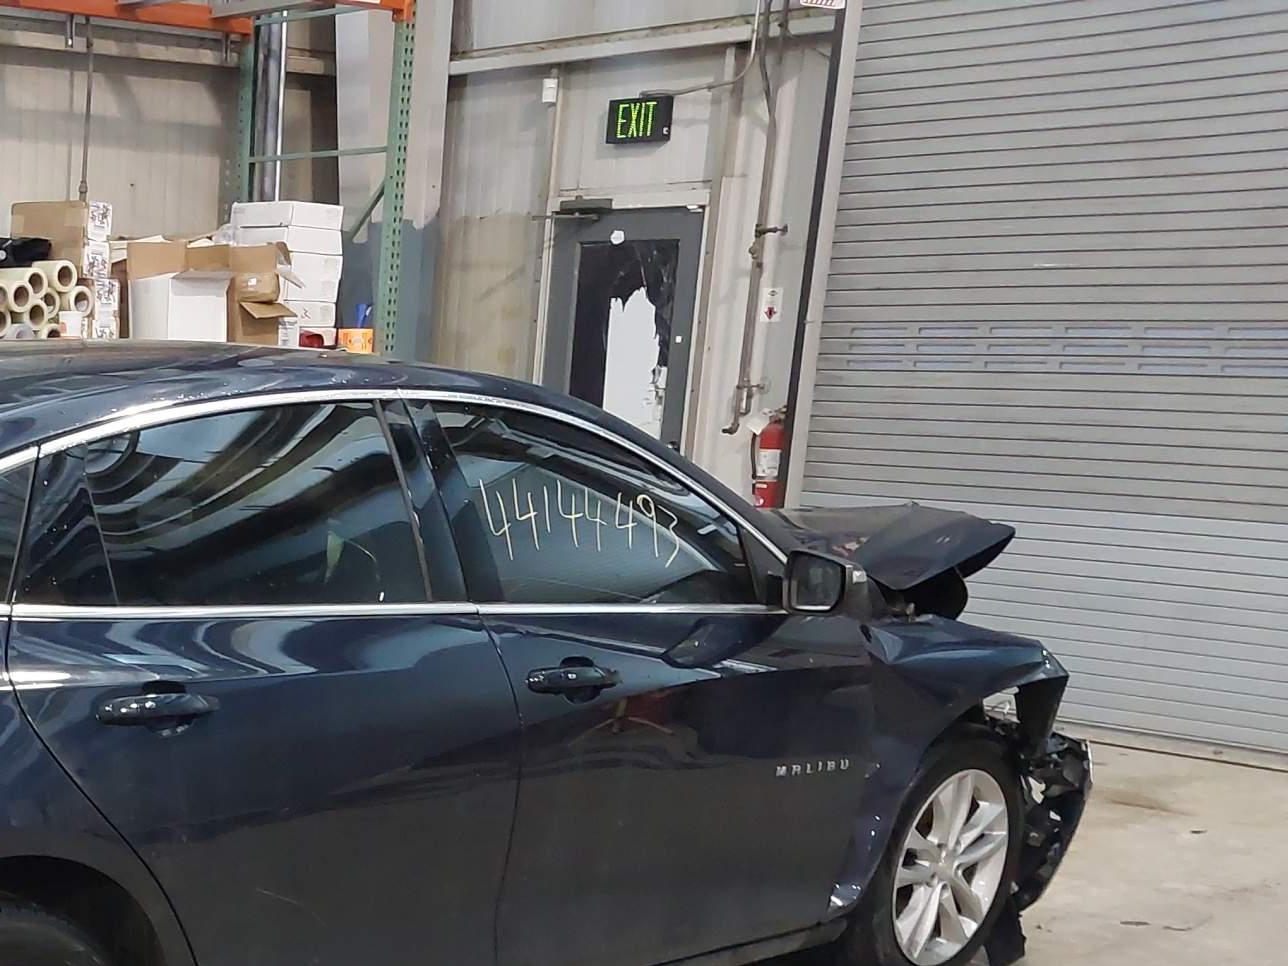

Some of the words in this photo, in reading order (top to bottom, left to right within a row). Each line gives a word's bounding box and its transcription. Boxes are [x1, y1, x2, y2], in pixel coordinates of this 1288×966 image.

[616, 101, 658, 139] EXIT
[479, 478, 680, 569] 44144493
[775, 758, 850, 777] MALIBU
